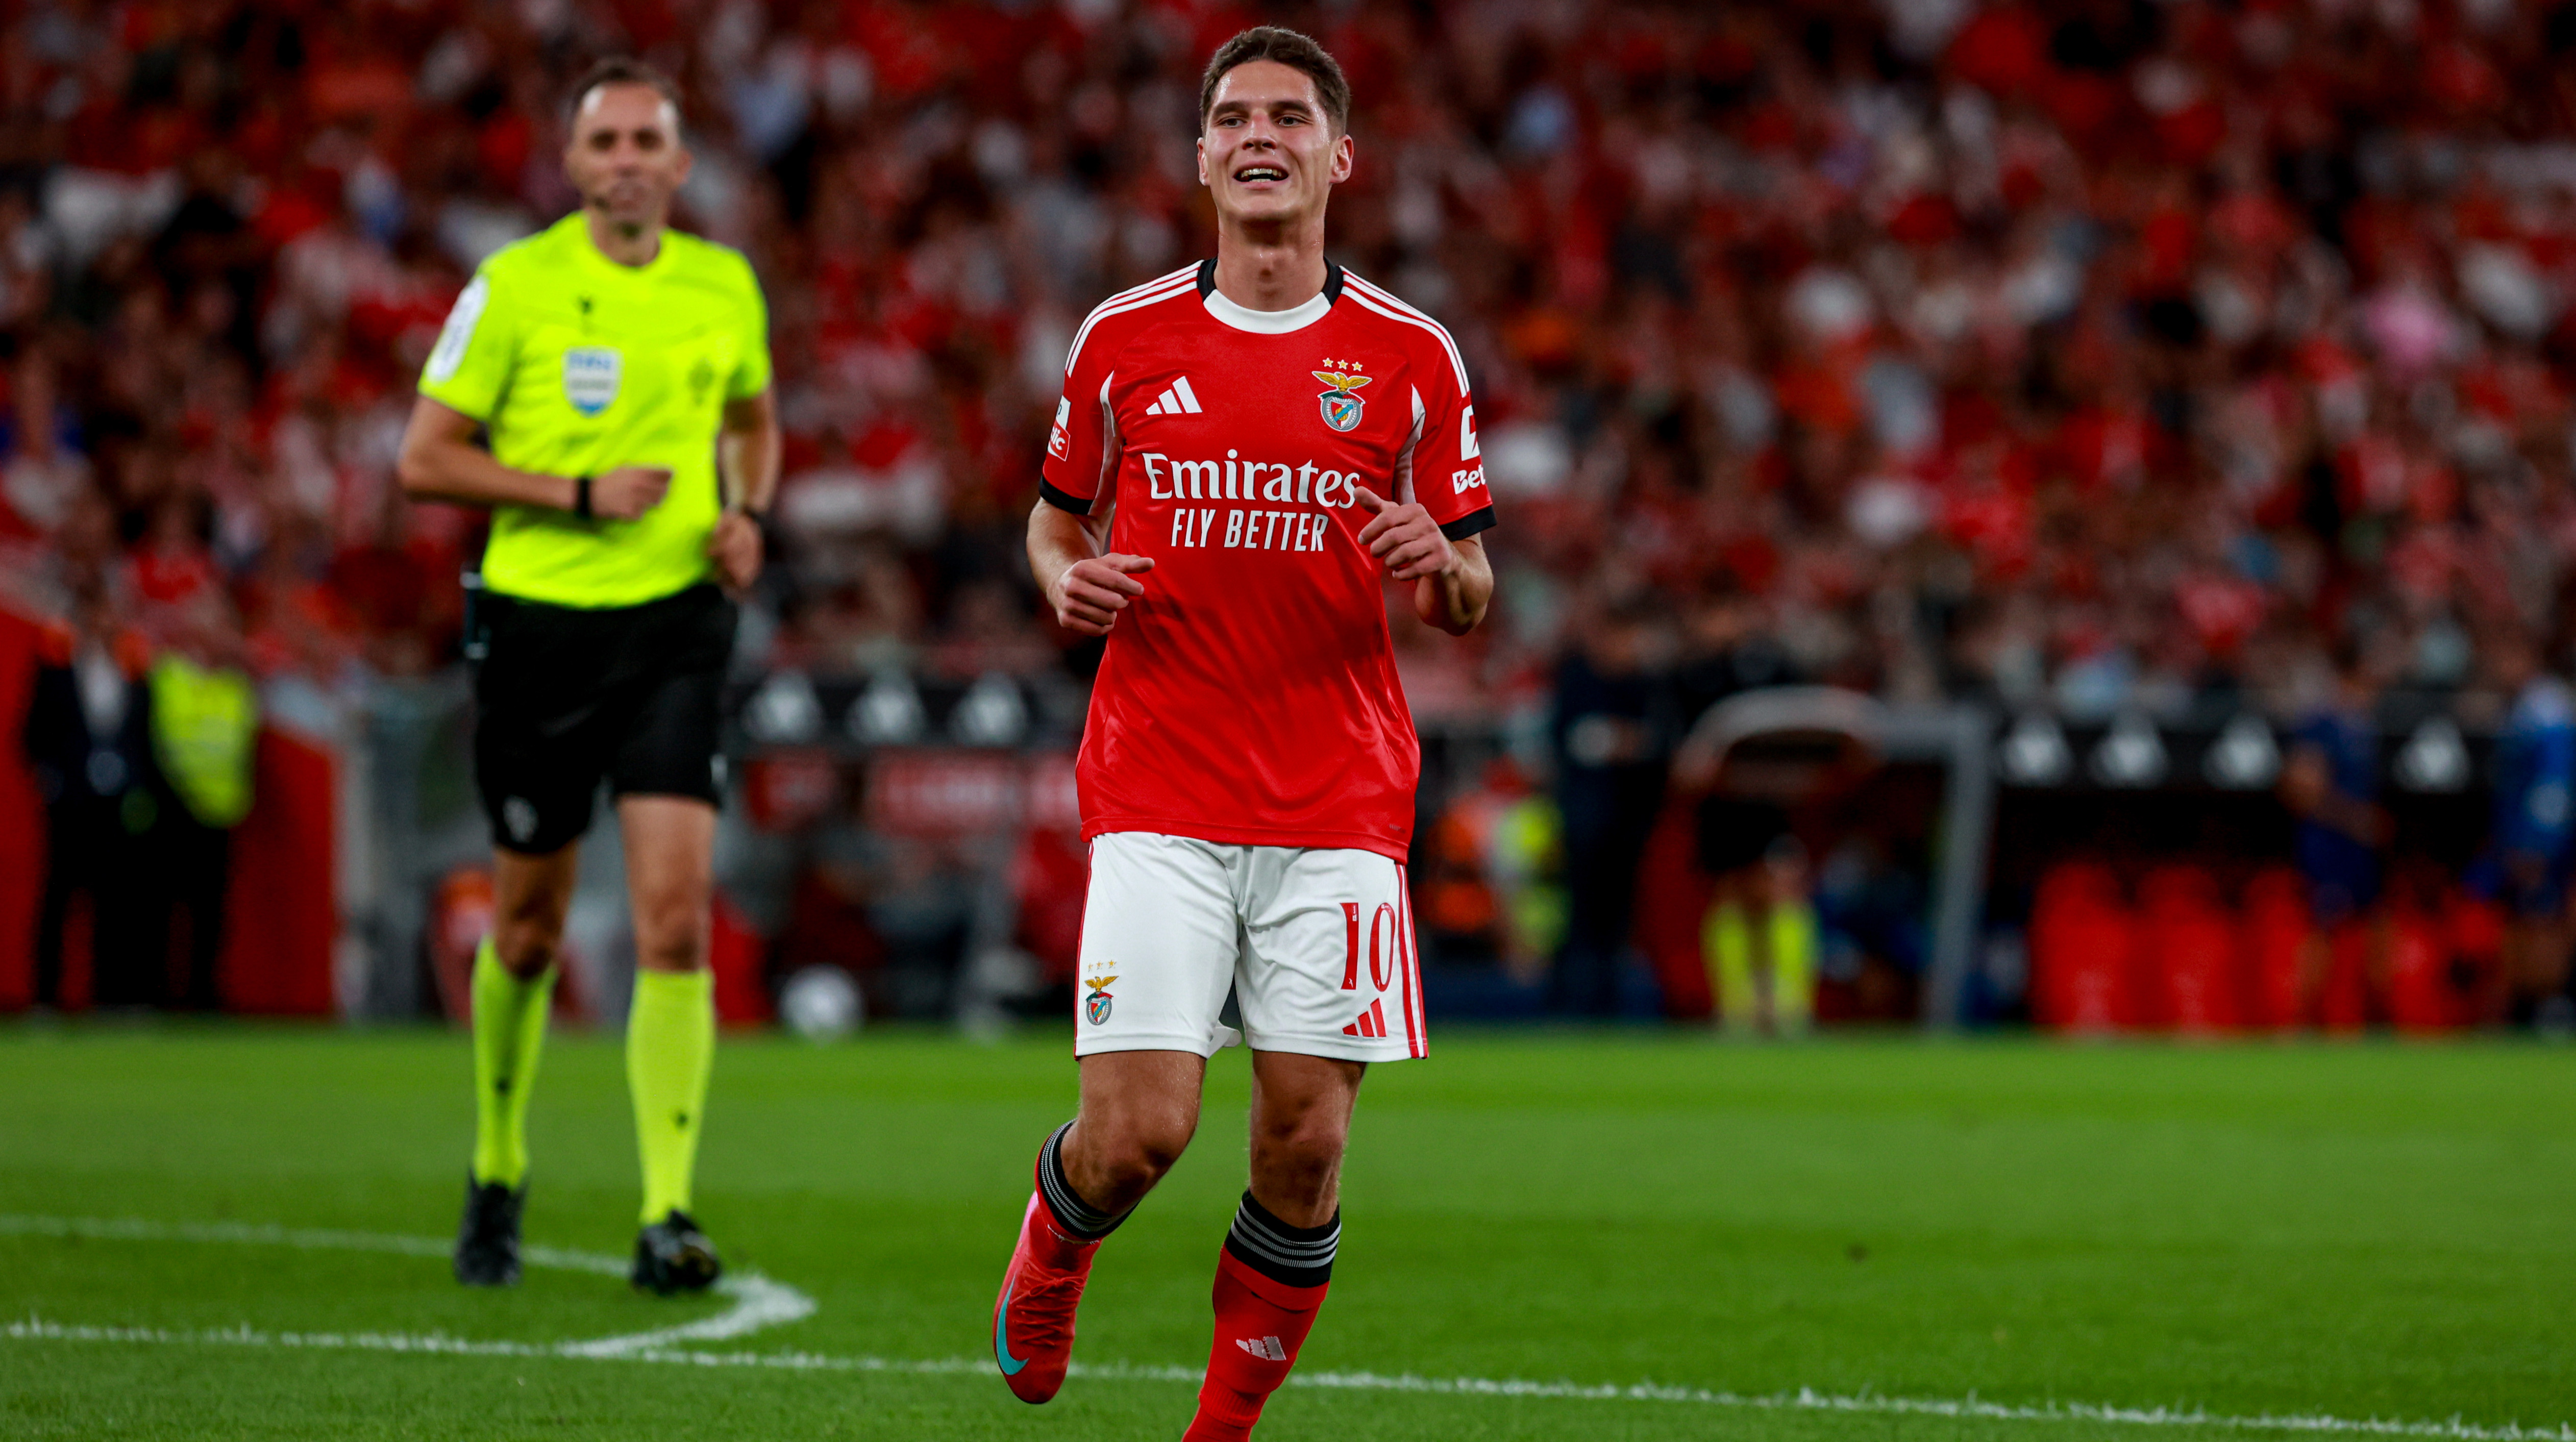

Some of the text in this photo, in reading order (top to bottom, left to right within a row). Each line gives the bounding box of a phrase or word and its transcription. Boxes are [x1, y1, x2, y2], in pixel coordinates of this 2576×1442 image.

[1142, 449, 1360, 509] Emirates
[1171, 509, 1329, 552] FLY BETTER
[1340, 902, 1396, 992] 10
